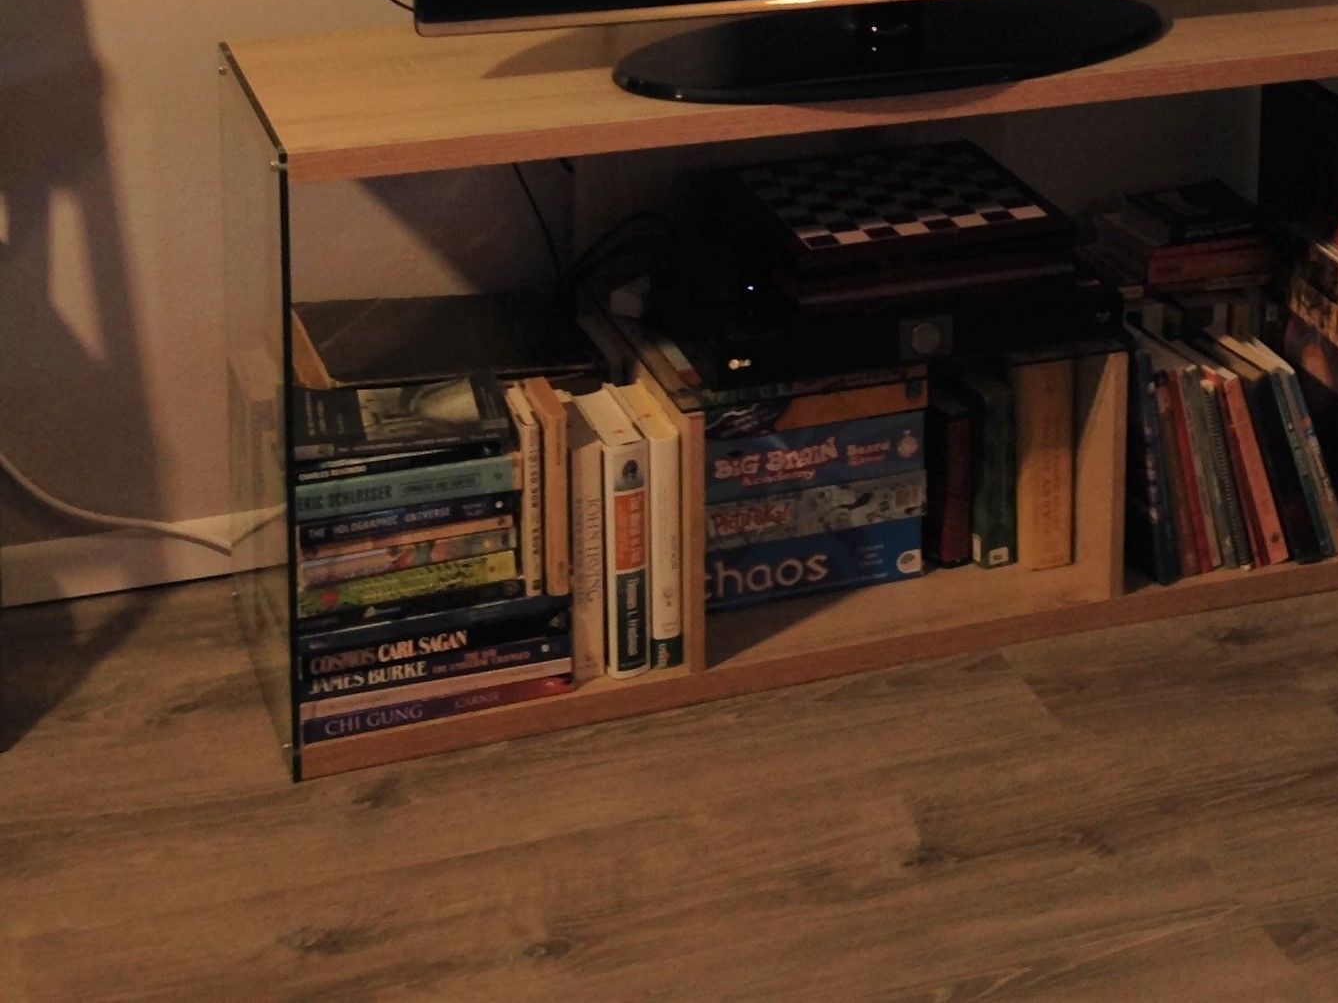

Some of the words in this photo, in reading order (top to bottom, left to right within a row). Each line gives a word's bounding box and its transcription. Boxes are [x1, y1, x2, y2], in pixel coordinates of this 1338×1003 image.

[377, 638, 415, 663] CARL
[416, 629, 469, 655] SAGAN
[309, 670, 365, 695] JAMES
[368, 660, 429, 686] BURKE
[323, 715, 361, 736] CHI
[366, 704, 424, 728] GUNG
